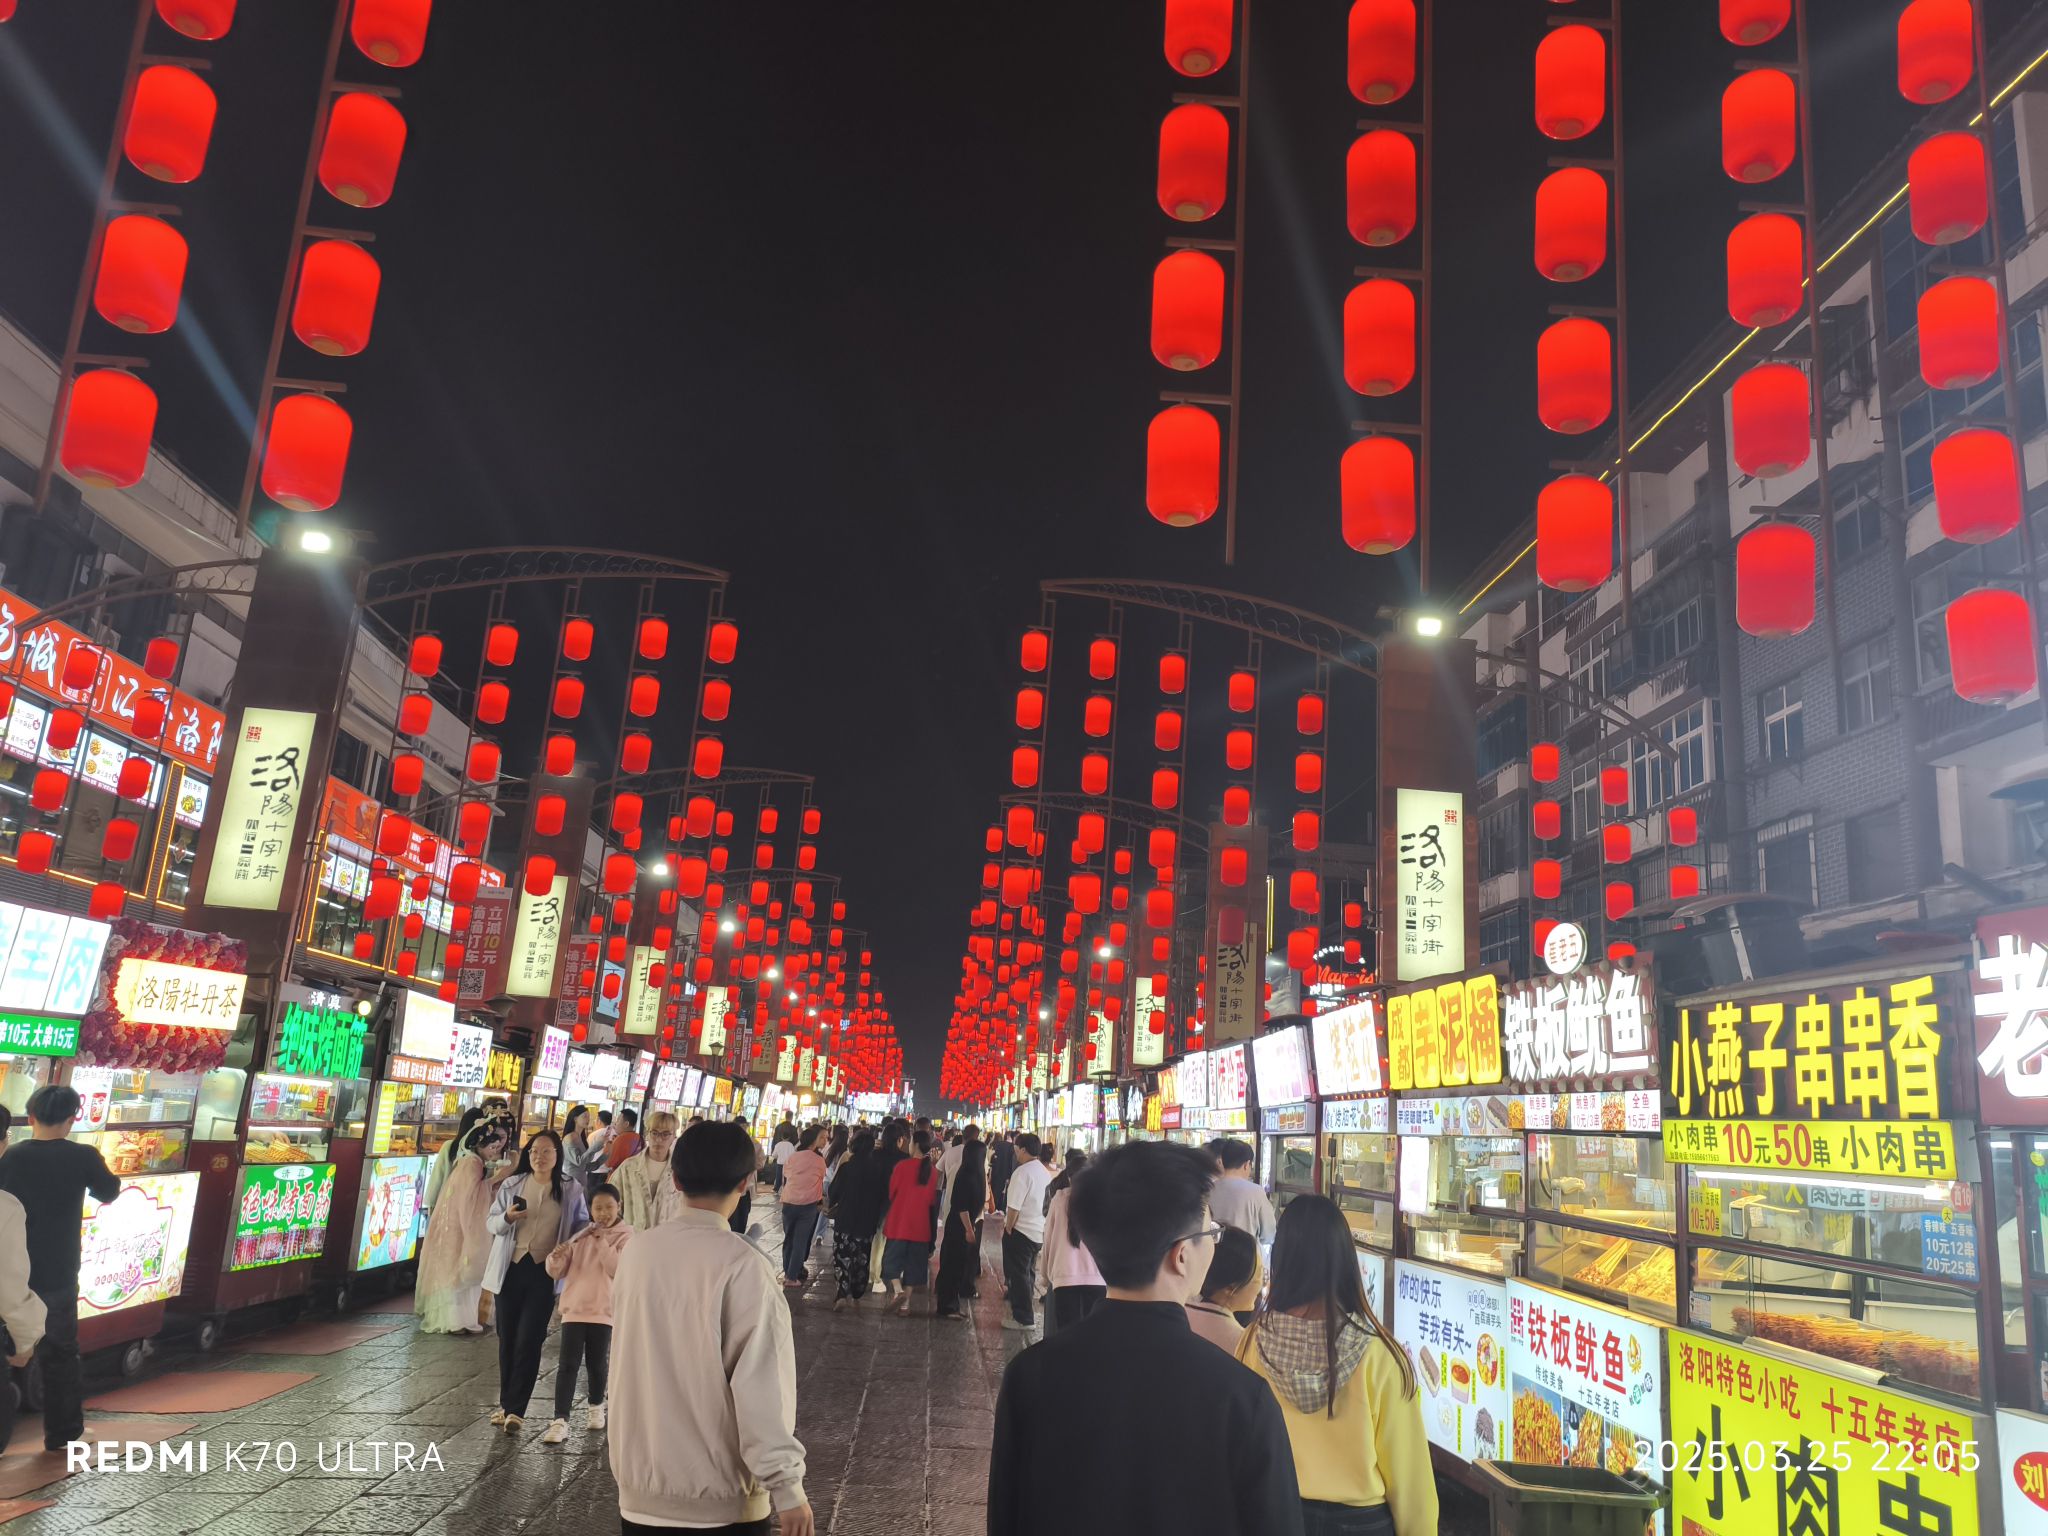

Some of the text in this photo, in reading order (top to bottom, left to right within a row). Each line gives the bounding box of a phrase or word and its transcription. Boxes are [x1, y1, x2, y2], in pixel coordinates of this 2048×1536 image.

[0, 603, 60, 688] 城
[136, 975, 239, 1018] 洛陽牡丹茶
[31, 1023, 75, 1049] 大串15元
[278, 1001, 368, 1080] 绝味烤面筋
[1504, 969, 1650, 1082] 铁板鱿鱼
[1671, 975, 1942, 1119] 小燕子串串香
[453, 1061, 484, 1084] 五花肉
[1632, 1092, 1650, 1109] 全鱼
[1628, 1113, 1660, 1129] 15元/串
[212, 1156, 228, 1169] 25
[1841, 1124, 1947, 1176] 小肉串
[1944, 1211, 1952, 1221] 大
[1925, 1237, 1976, 1257] 10元12串
[1926, 1257, 1977, 1278] 20元25串
[1399, 1269, 1442, 1309] 你的快乐
[1527, 1301, 1627, 1395] 铁板鱿鱼
[1678, 1341, 1802, 1420] 洛阳特色小吃
[1820, 1387, 1962, 1477] 十五年老店
